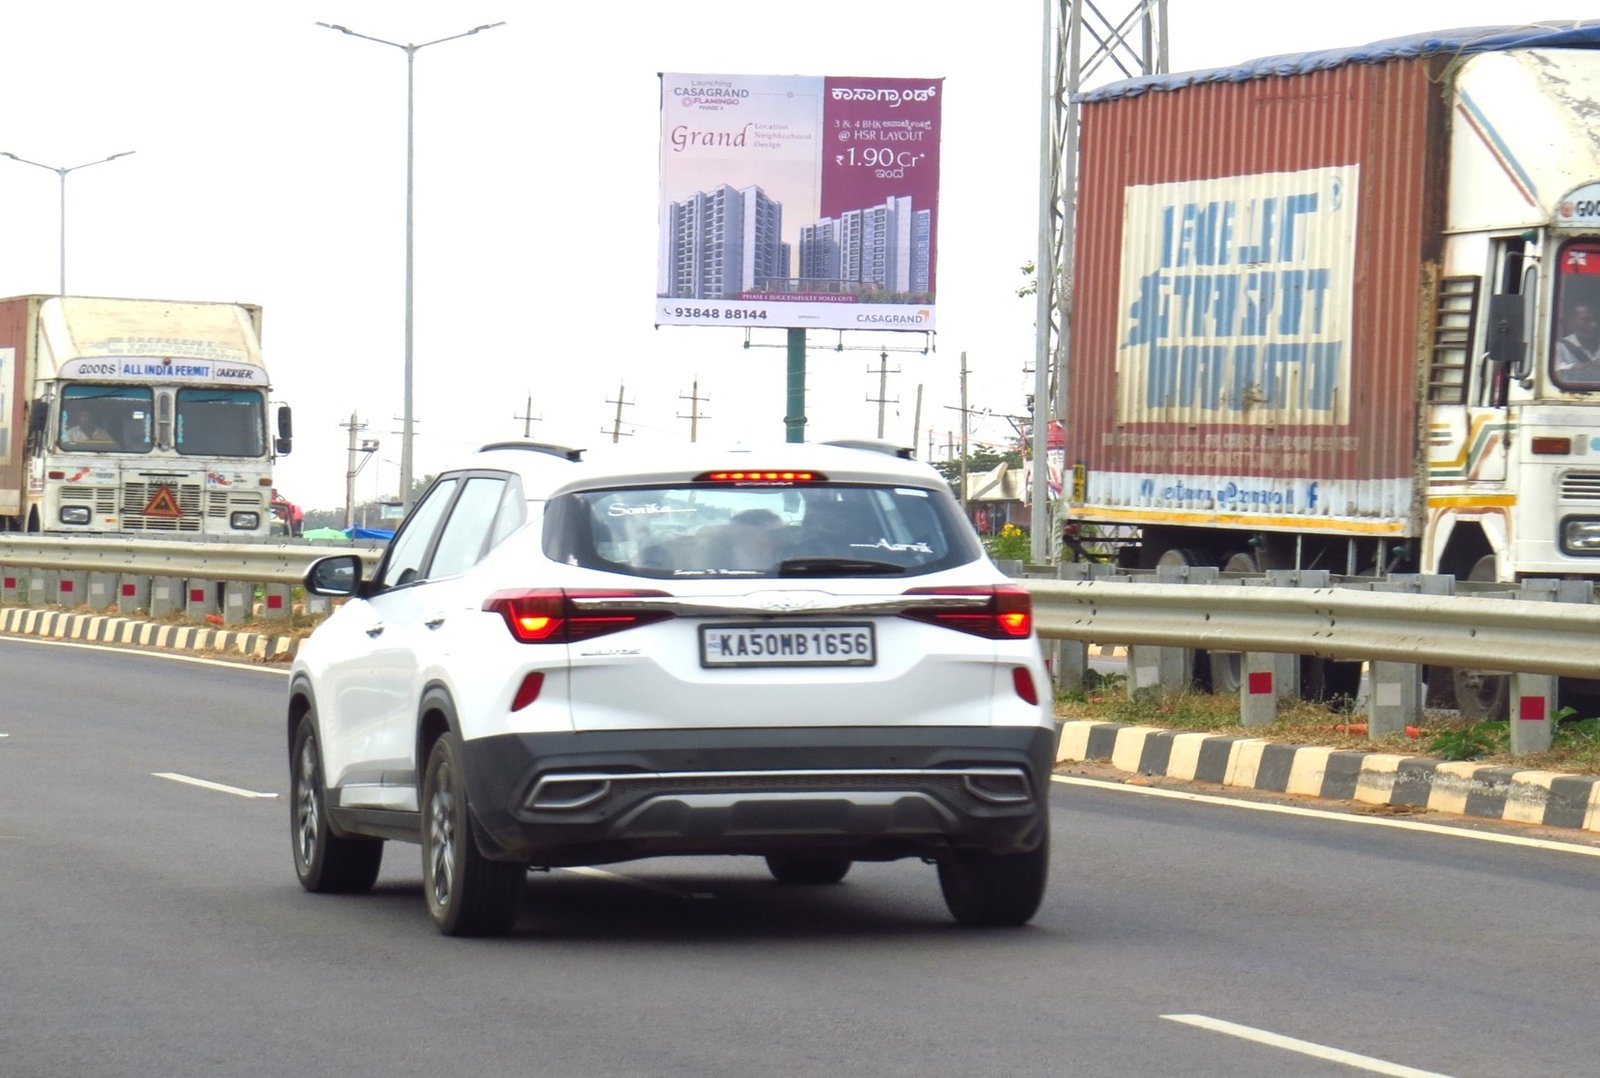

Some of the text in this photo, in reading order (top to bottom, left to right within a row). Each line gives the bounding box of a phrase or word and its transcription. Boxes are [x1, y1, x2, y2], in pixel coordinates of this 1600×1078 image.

[674, 87, 749, 98] CASAGRAND
[693, 97, 740, 106] FLAMINGO
[834, 120, 840, 128] 3
[843, 120, 851, 128] &
[855, 120, 860, 128] 4
[862, 120, 882, 129] BHK
[671, 122, 753, 152] Grand
[838, 130, 924, 141] @ HSR LAYOUT
[675, 307, 768, 320] 93848 88144
[856, 314, 923, 324] CASAGRAND
[79, 363, 254, 380] GOODS ALL INDIA PERMIT CARRIER
[720, 633, 868, 656] KA50MB1656
